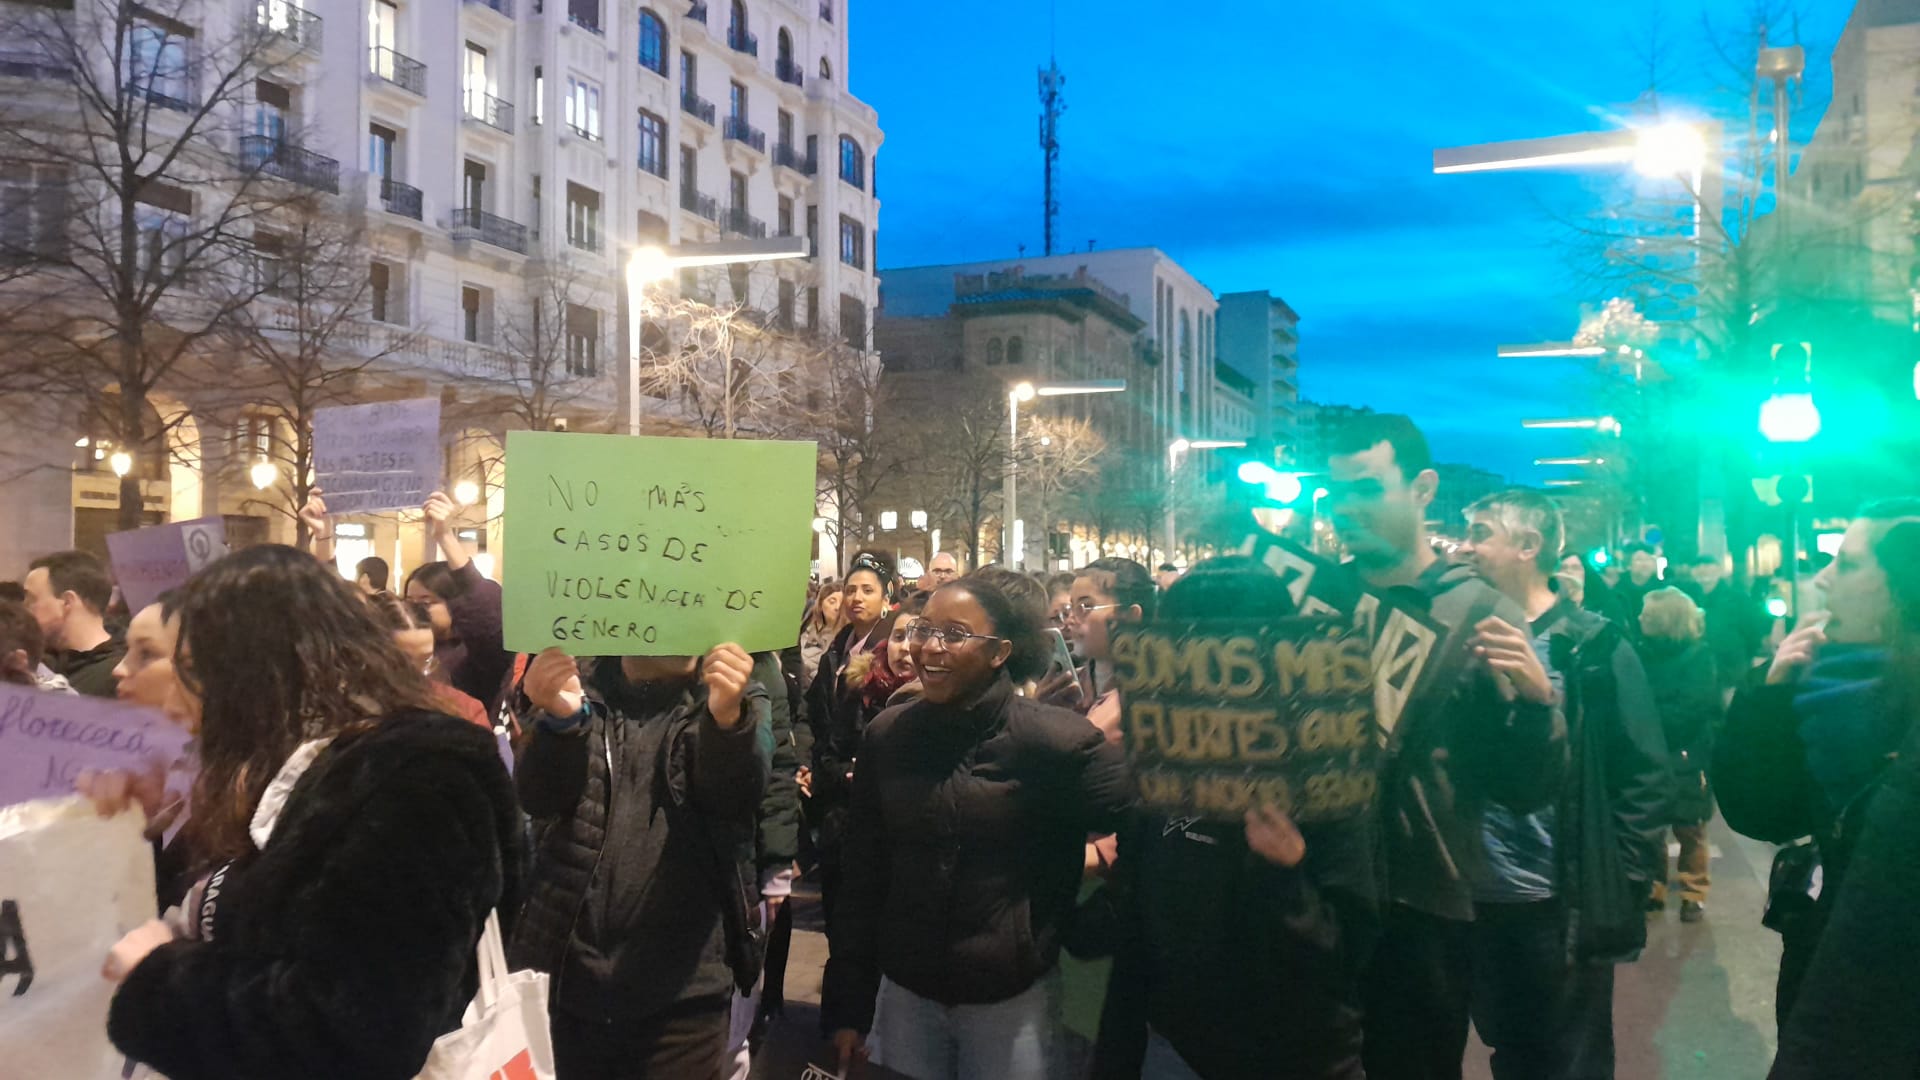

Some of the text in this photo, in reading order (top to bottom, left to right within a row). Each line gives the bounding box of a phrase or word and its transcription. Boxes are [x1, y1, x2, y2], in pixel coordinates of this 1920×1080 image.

[548, 474, 706, 512] NO MÁS
[553, 527, 708, 562] CASOS DE
[546, 571, 763, 611] VIOLENCIA DE
[552, 615, 657, 643] GÉNERO
[1112, 633, 1264, 697] SOMOS
